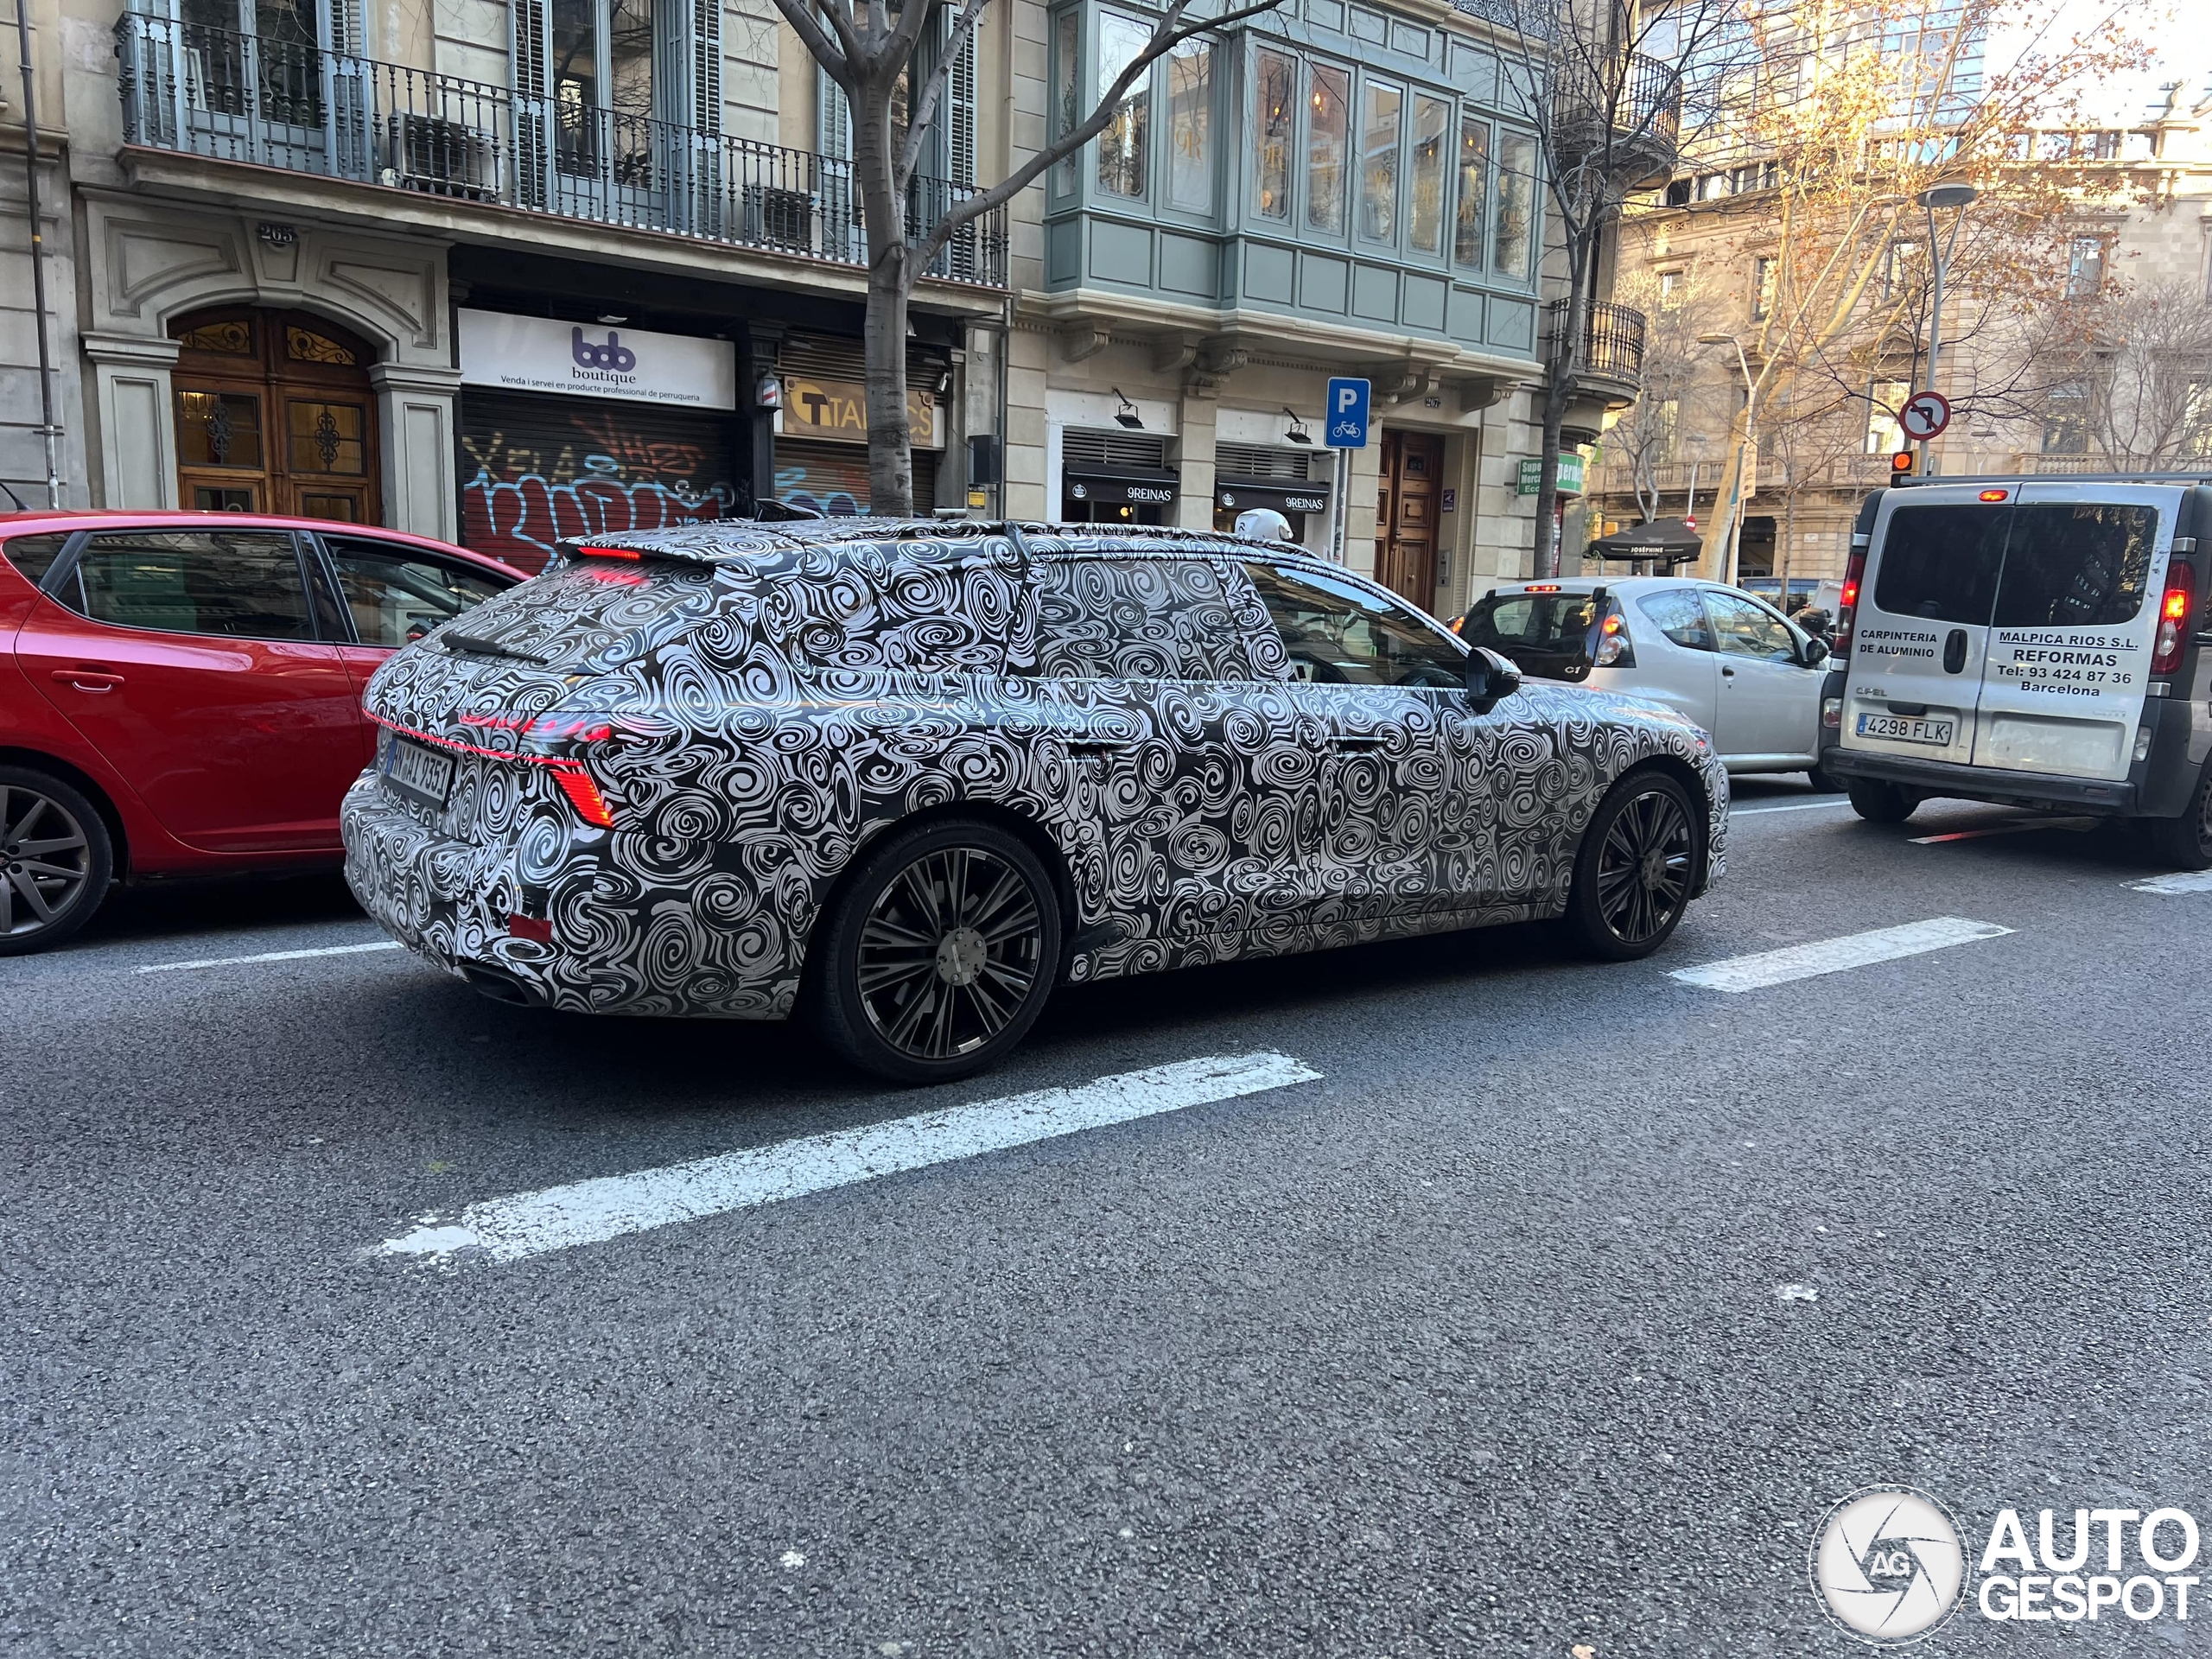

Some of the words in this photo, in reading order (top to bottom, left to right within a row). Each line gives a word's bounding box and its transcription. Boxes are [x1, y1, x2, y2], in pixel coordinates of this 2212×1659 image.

[1176, 129, 1203, 161] 9R
[260, 225, 293, 242] 265
[572, 366, 637, 385] boutique
[500, 375, 526, 385] Venda
[532, 379, 555, 388] servei
[568, 383, 601, 391] producte
[603, 386, 647, 397] professional
[659, 391, 700, 402] perruqueria
[1338, 388, 1357, 413] P
[1522, 461, 1542, 474] Supe
[1127, 486, 1172, 501] 9REINAS
[1285, 497, 1324, 510] 9REINAS
[1860, 629, 1937, 642] CARPINTERIA
[1999, 632, 2063, 645] MALPICA
[2069, 636, 2106, 646] RIOS
[2111, 638, 2139, 648] S.L.
[1860, 645, 1874, 653] DE
[1877, 645, 1935, 658] ALUMINIO
[2013, 649, 2117, 667] REFORMAS
[1564, 665, 1581, 674] C1
[1997, 665, 2024, 677] Tel:
[2029, 667, 2047, 678] 93
[2052, 669, 2082, 680] 424
[2087, 671, 2107, 682] 87
[2112, 673, 2132, 683] 36
[1856, 687, 1888, 696] OPEL
[2020, 681, 2100, 696] Barcelona
[1868, 718, 1908, 736] 4298
[1913, 722, 1946, 741] FLK
[419, 756, 448, 795] 9351
